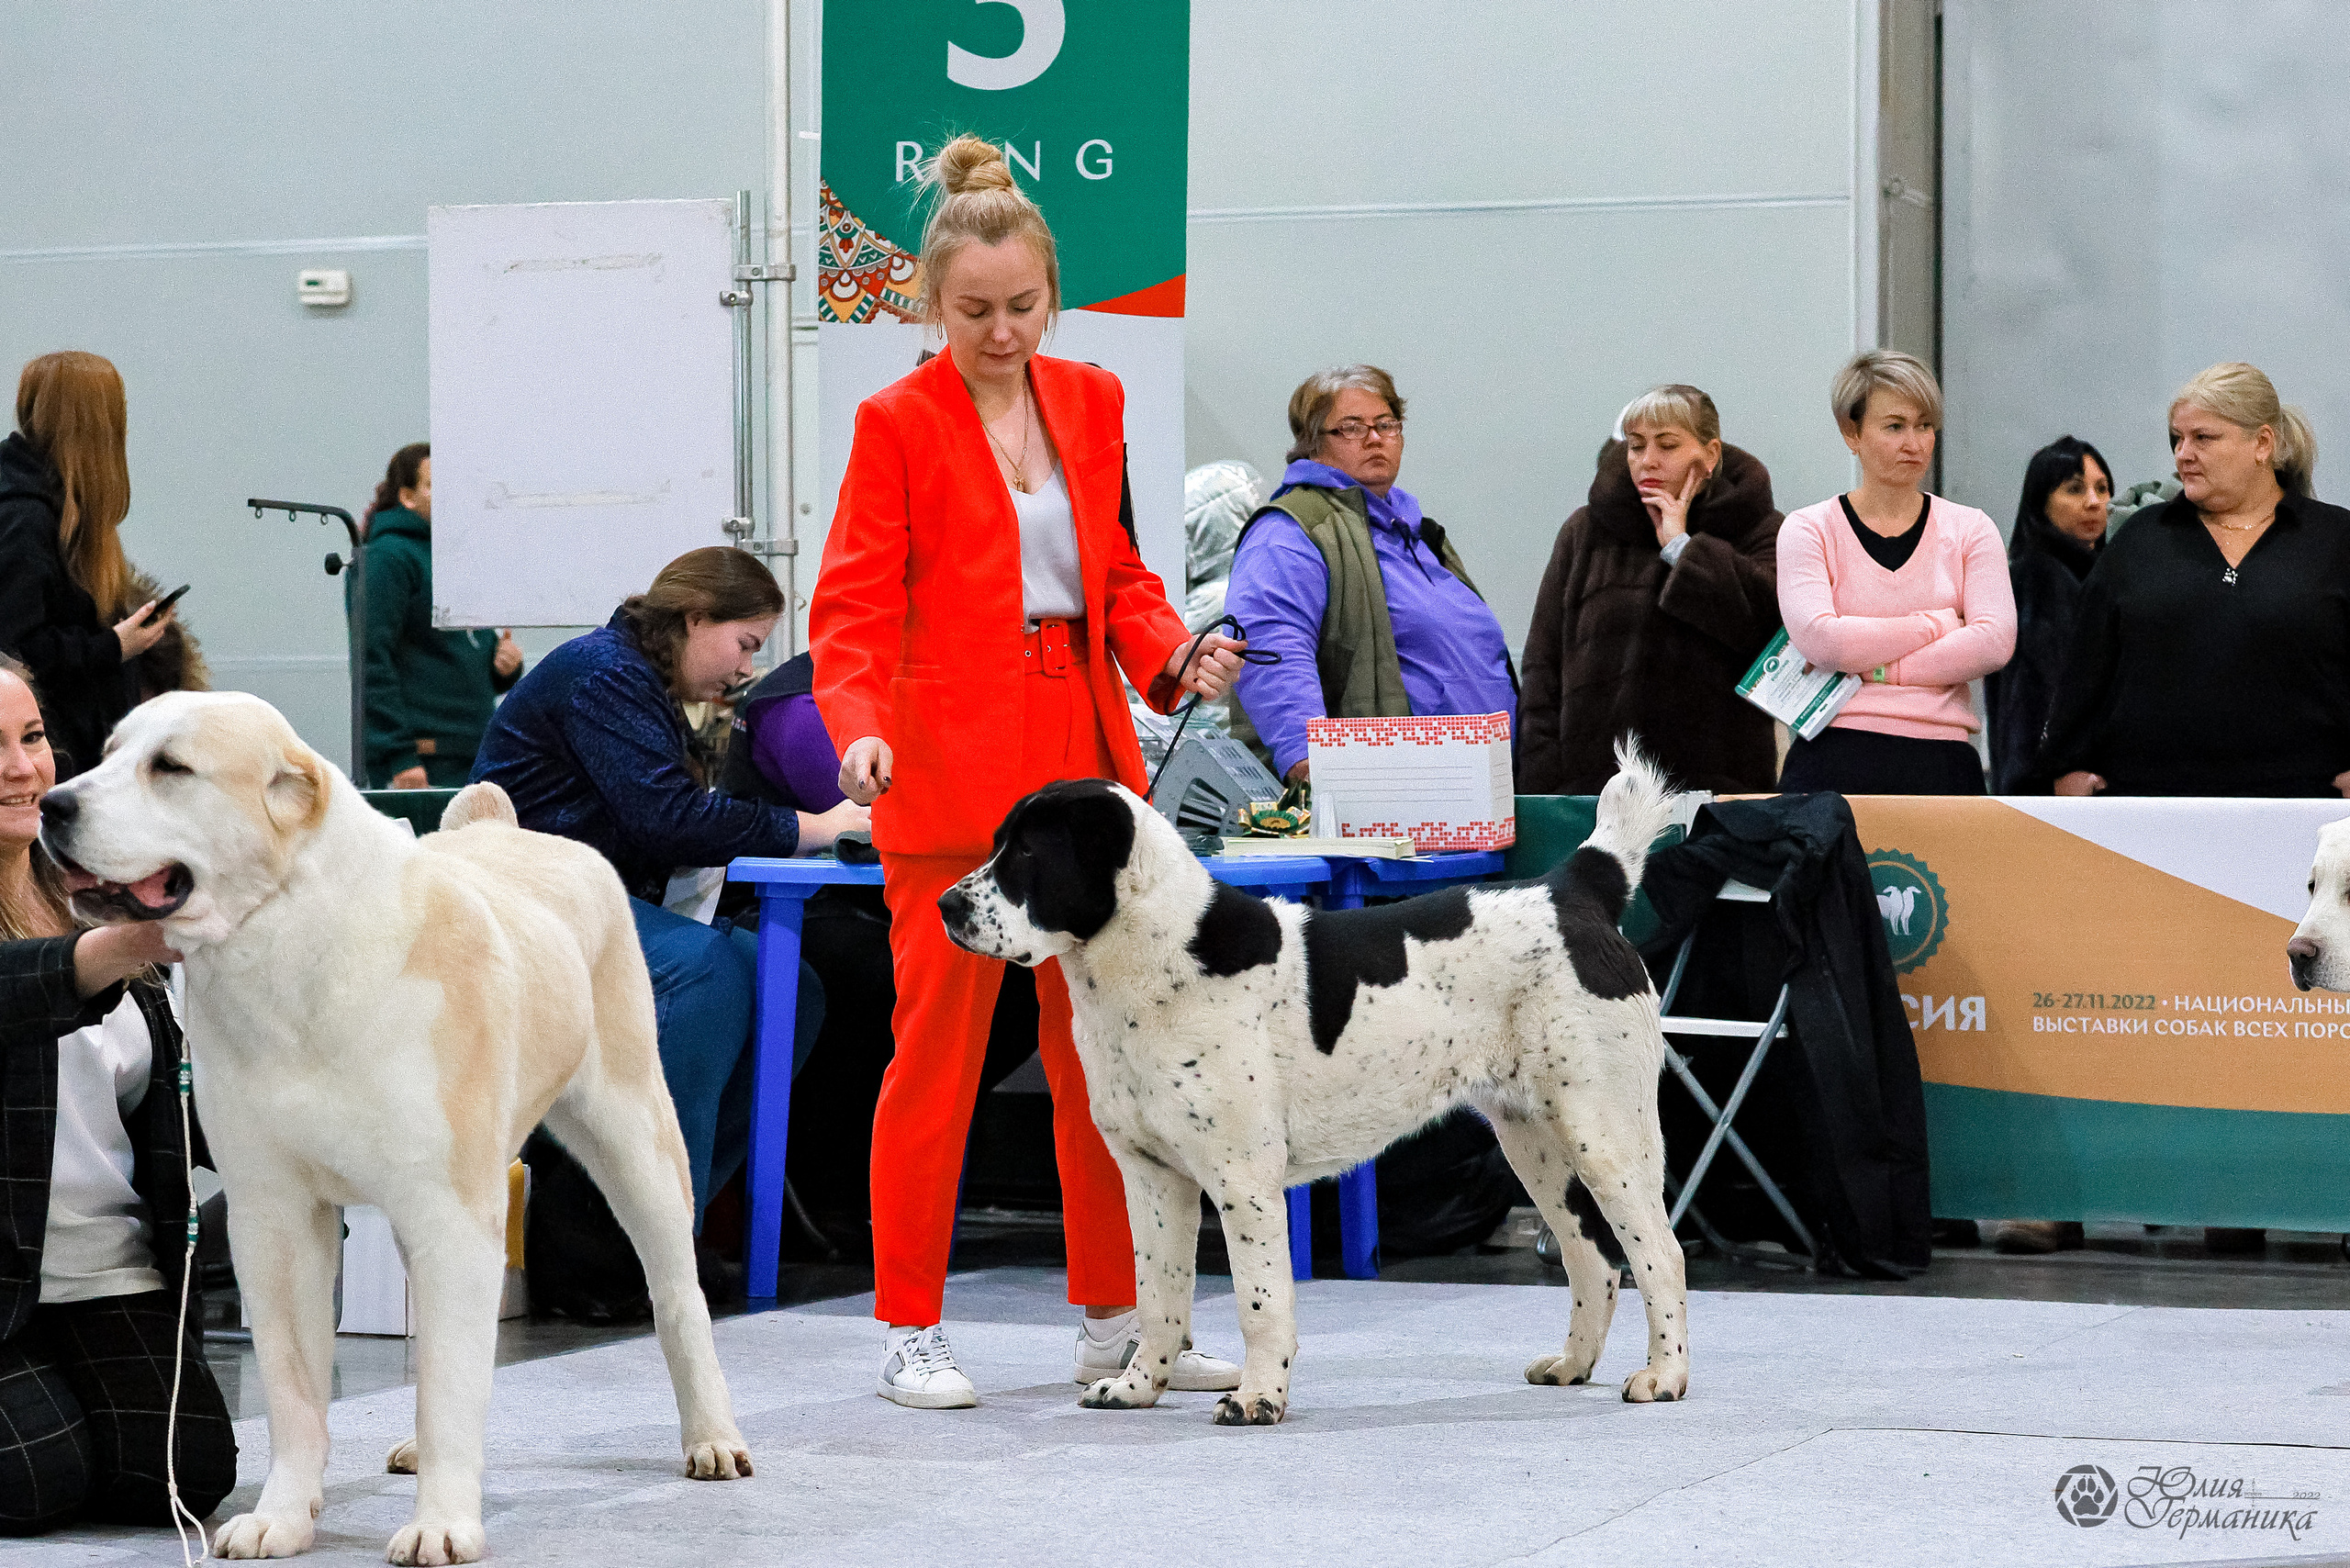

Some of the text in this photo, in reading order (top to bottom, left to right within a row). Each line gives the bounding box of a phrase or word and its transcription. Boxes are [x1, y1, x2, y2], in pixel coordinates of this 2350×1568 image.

[895, 139, 1113, 182] RNG
[2032, 991, 2156, 1011] 26-27.11.2022
[2032, 1015, 2148, 1036] ВЫСТАВКИ
[2154, 1018, 2227, 1036] СОБАК
[2233, 1021, 2288, 1038] ВСЕХ
